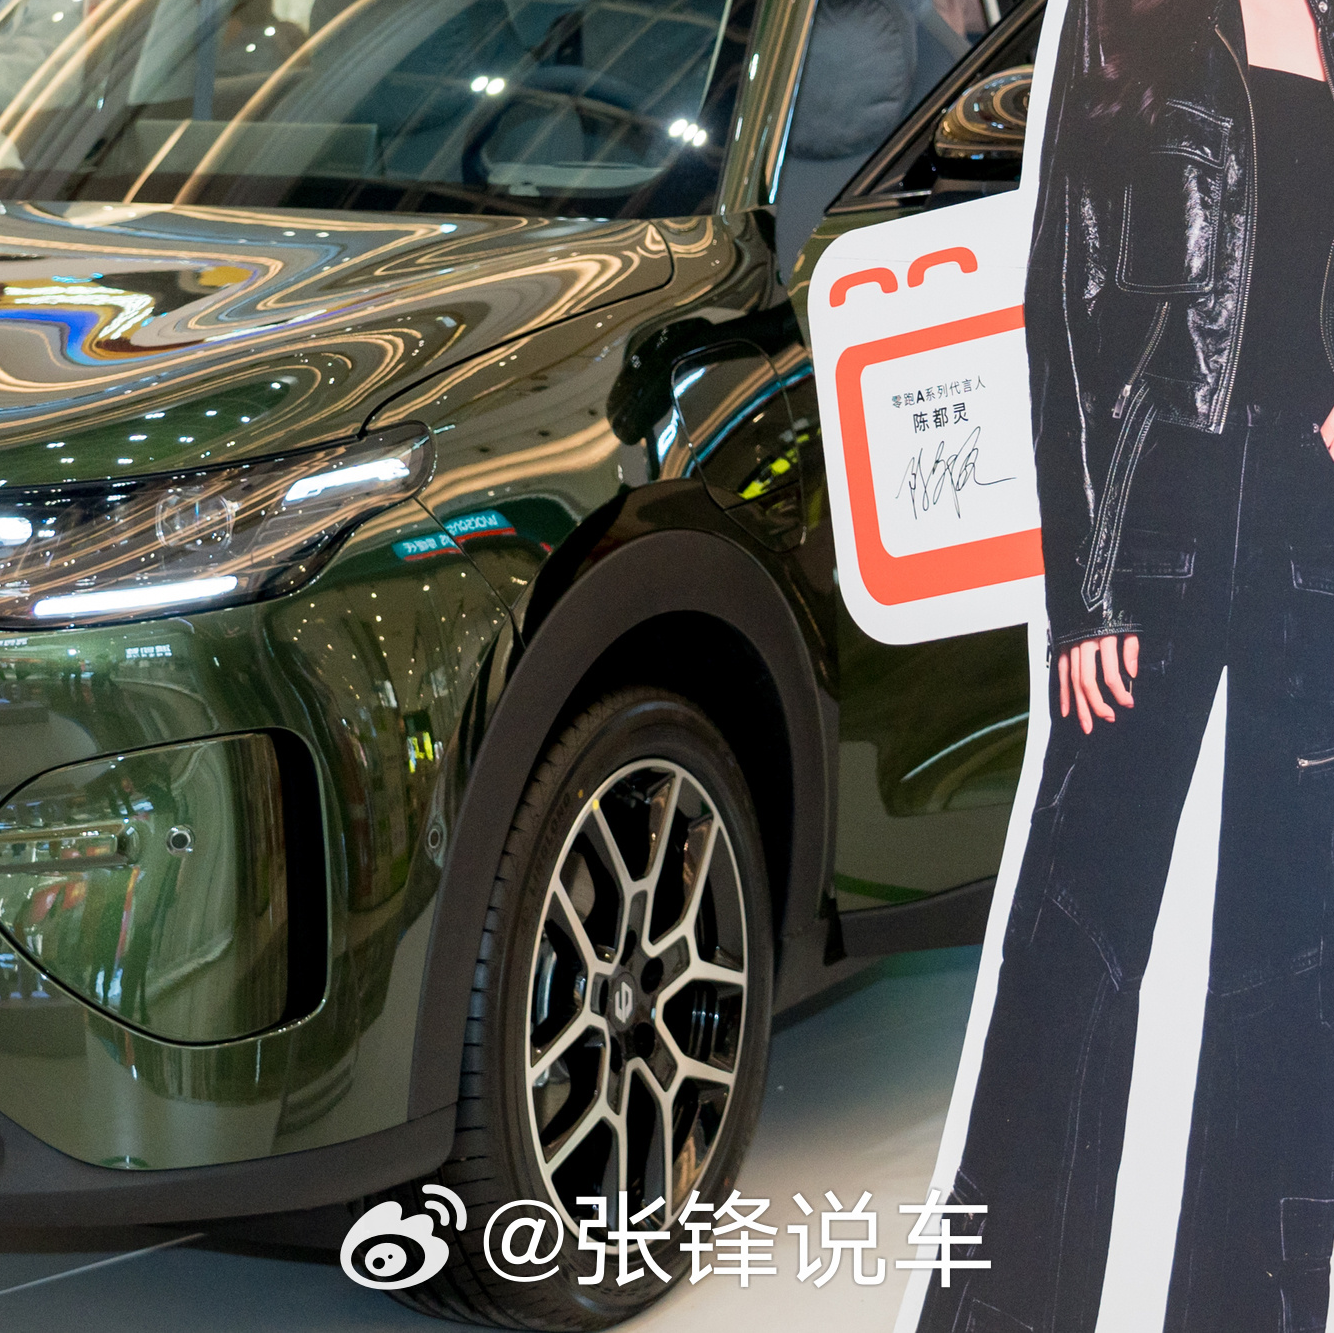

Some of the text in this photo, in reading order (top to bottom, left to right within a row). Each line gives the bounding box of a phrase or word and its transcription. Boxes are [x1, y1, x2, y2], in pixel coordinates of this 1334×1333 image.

[891, 375, 986, 409] 零跑A系列代言人
[912, 402, 969, 434] 陈都灵
